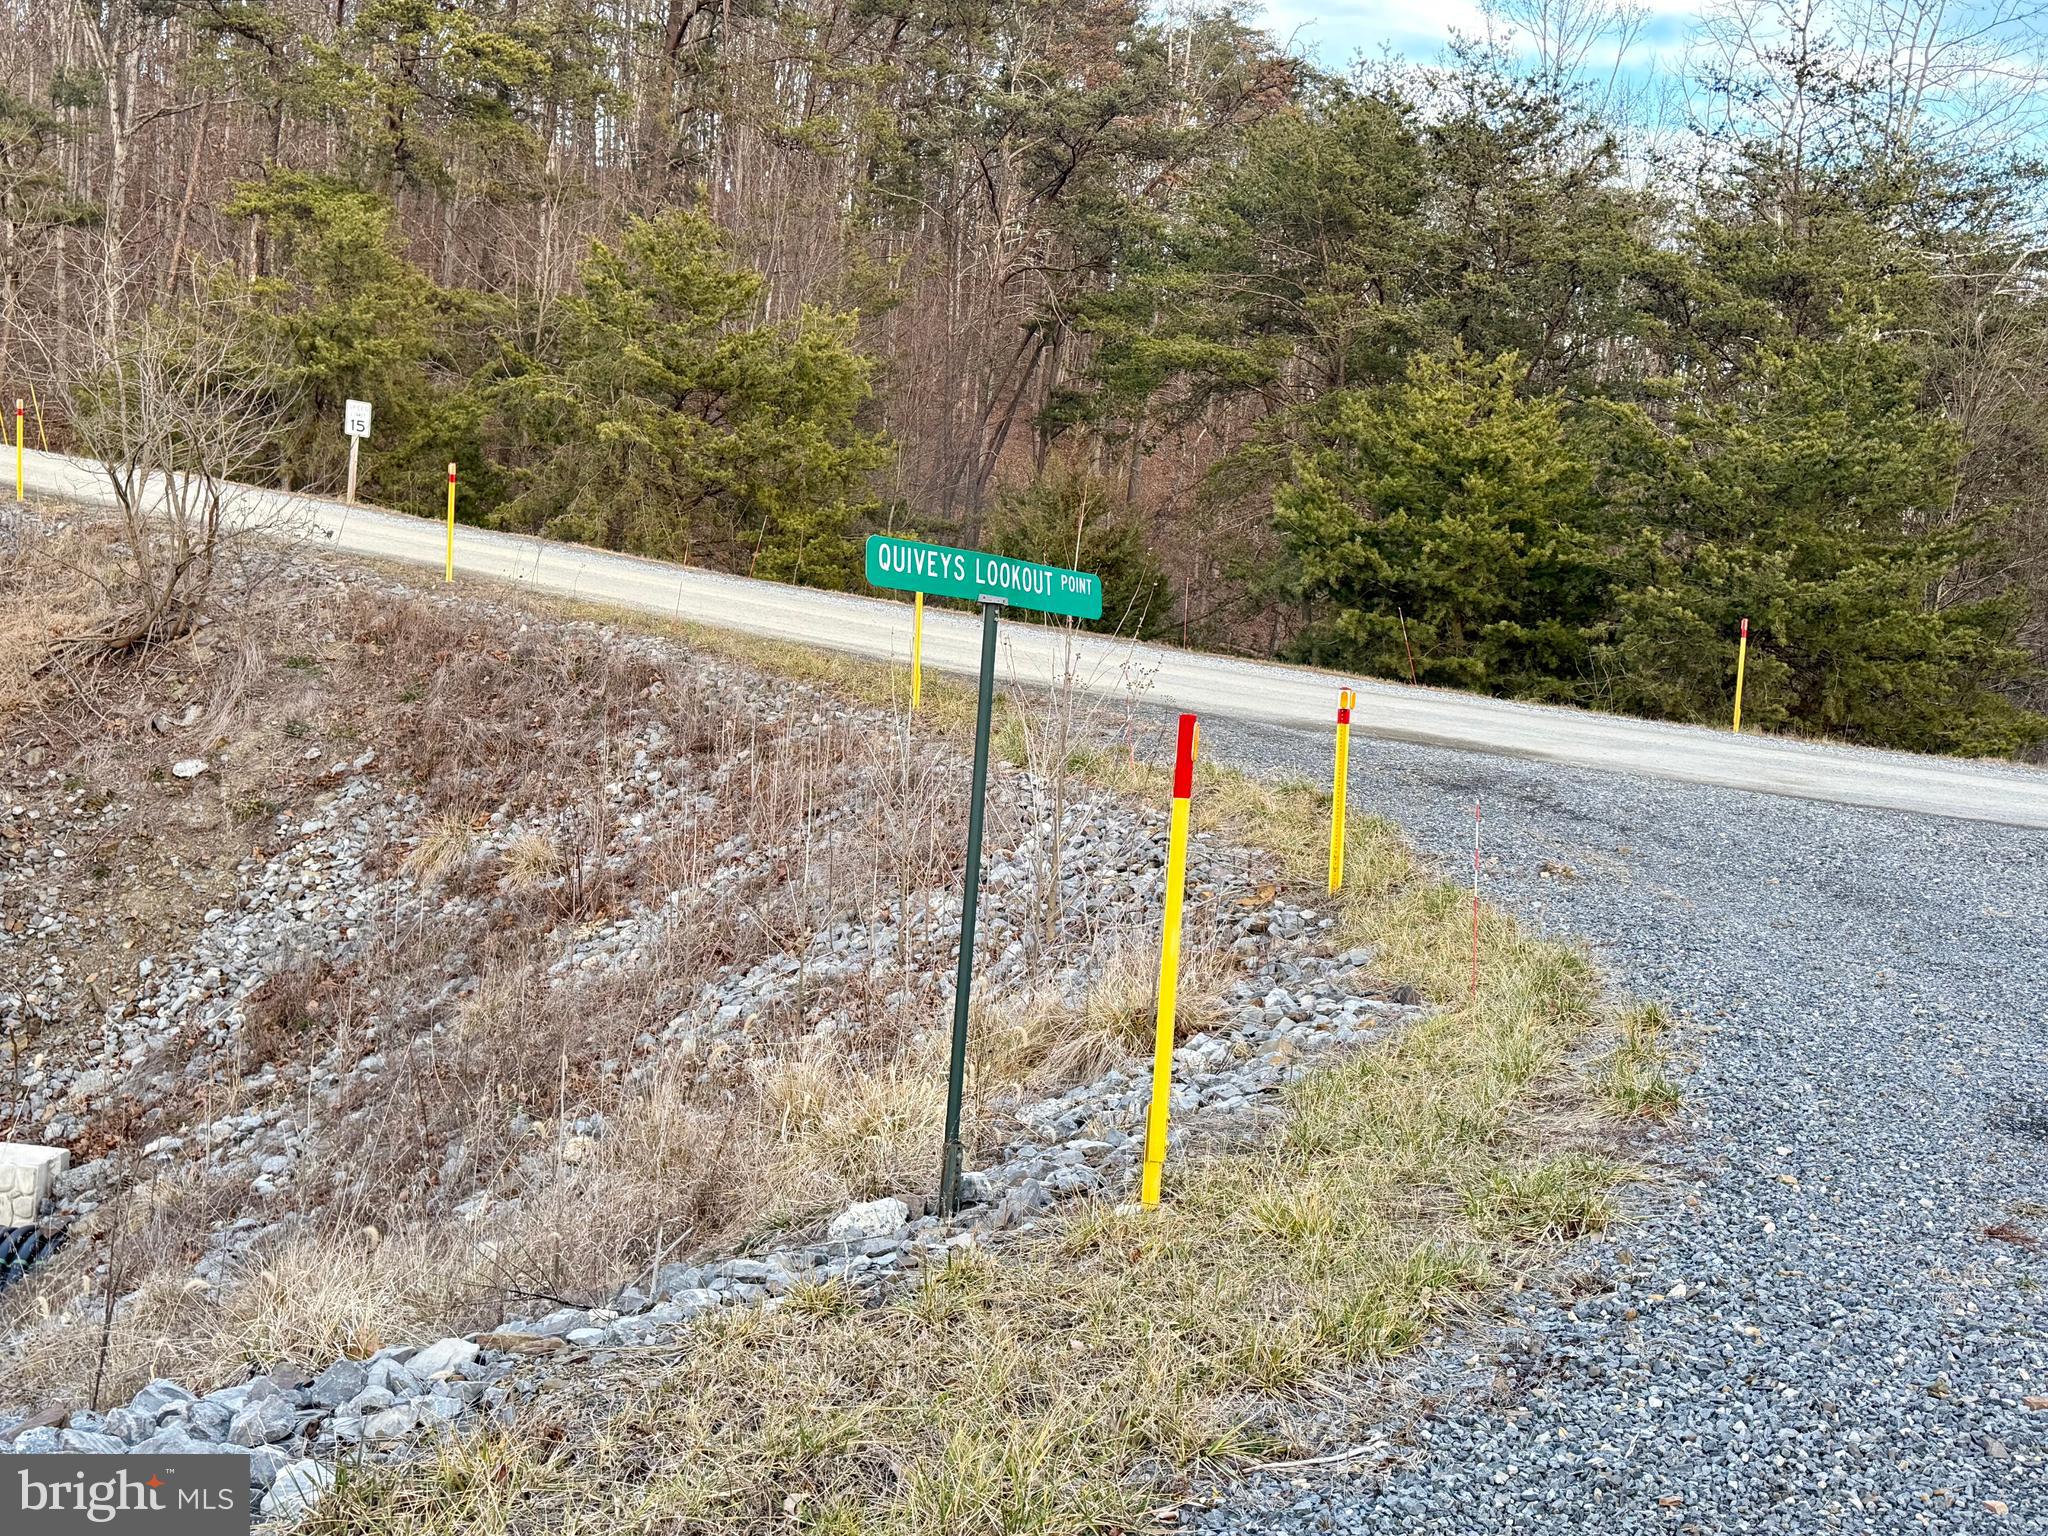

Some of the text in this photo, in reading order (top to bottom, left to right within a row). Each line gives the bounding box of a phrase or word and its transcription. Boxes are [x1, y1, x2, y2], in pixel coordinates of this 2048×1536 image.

[351, 419, 365, 432] 15
[878, 543, 1093, 596] QUIVEYS LOOKOUT POINT
